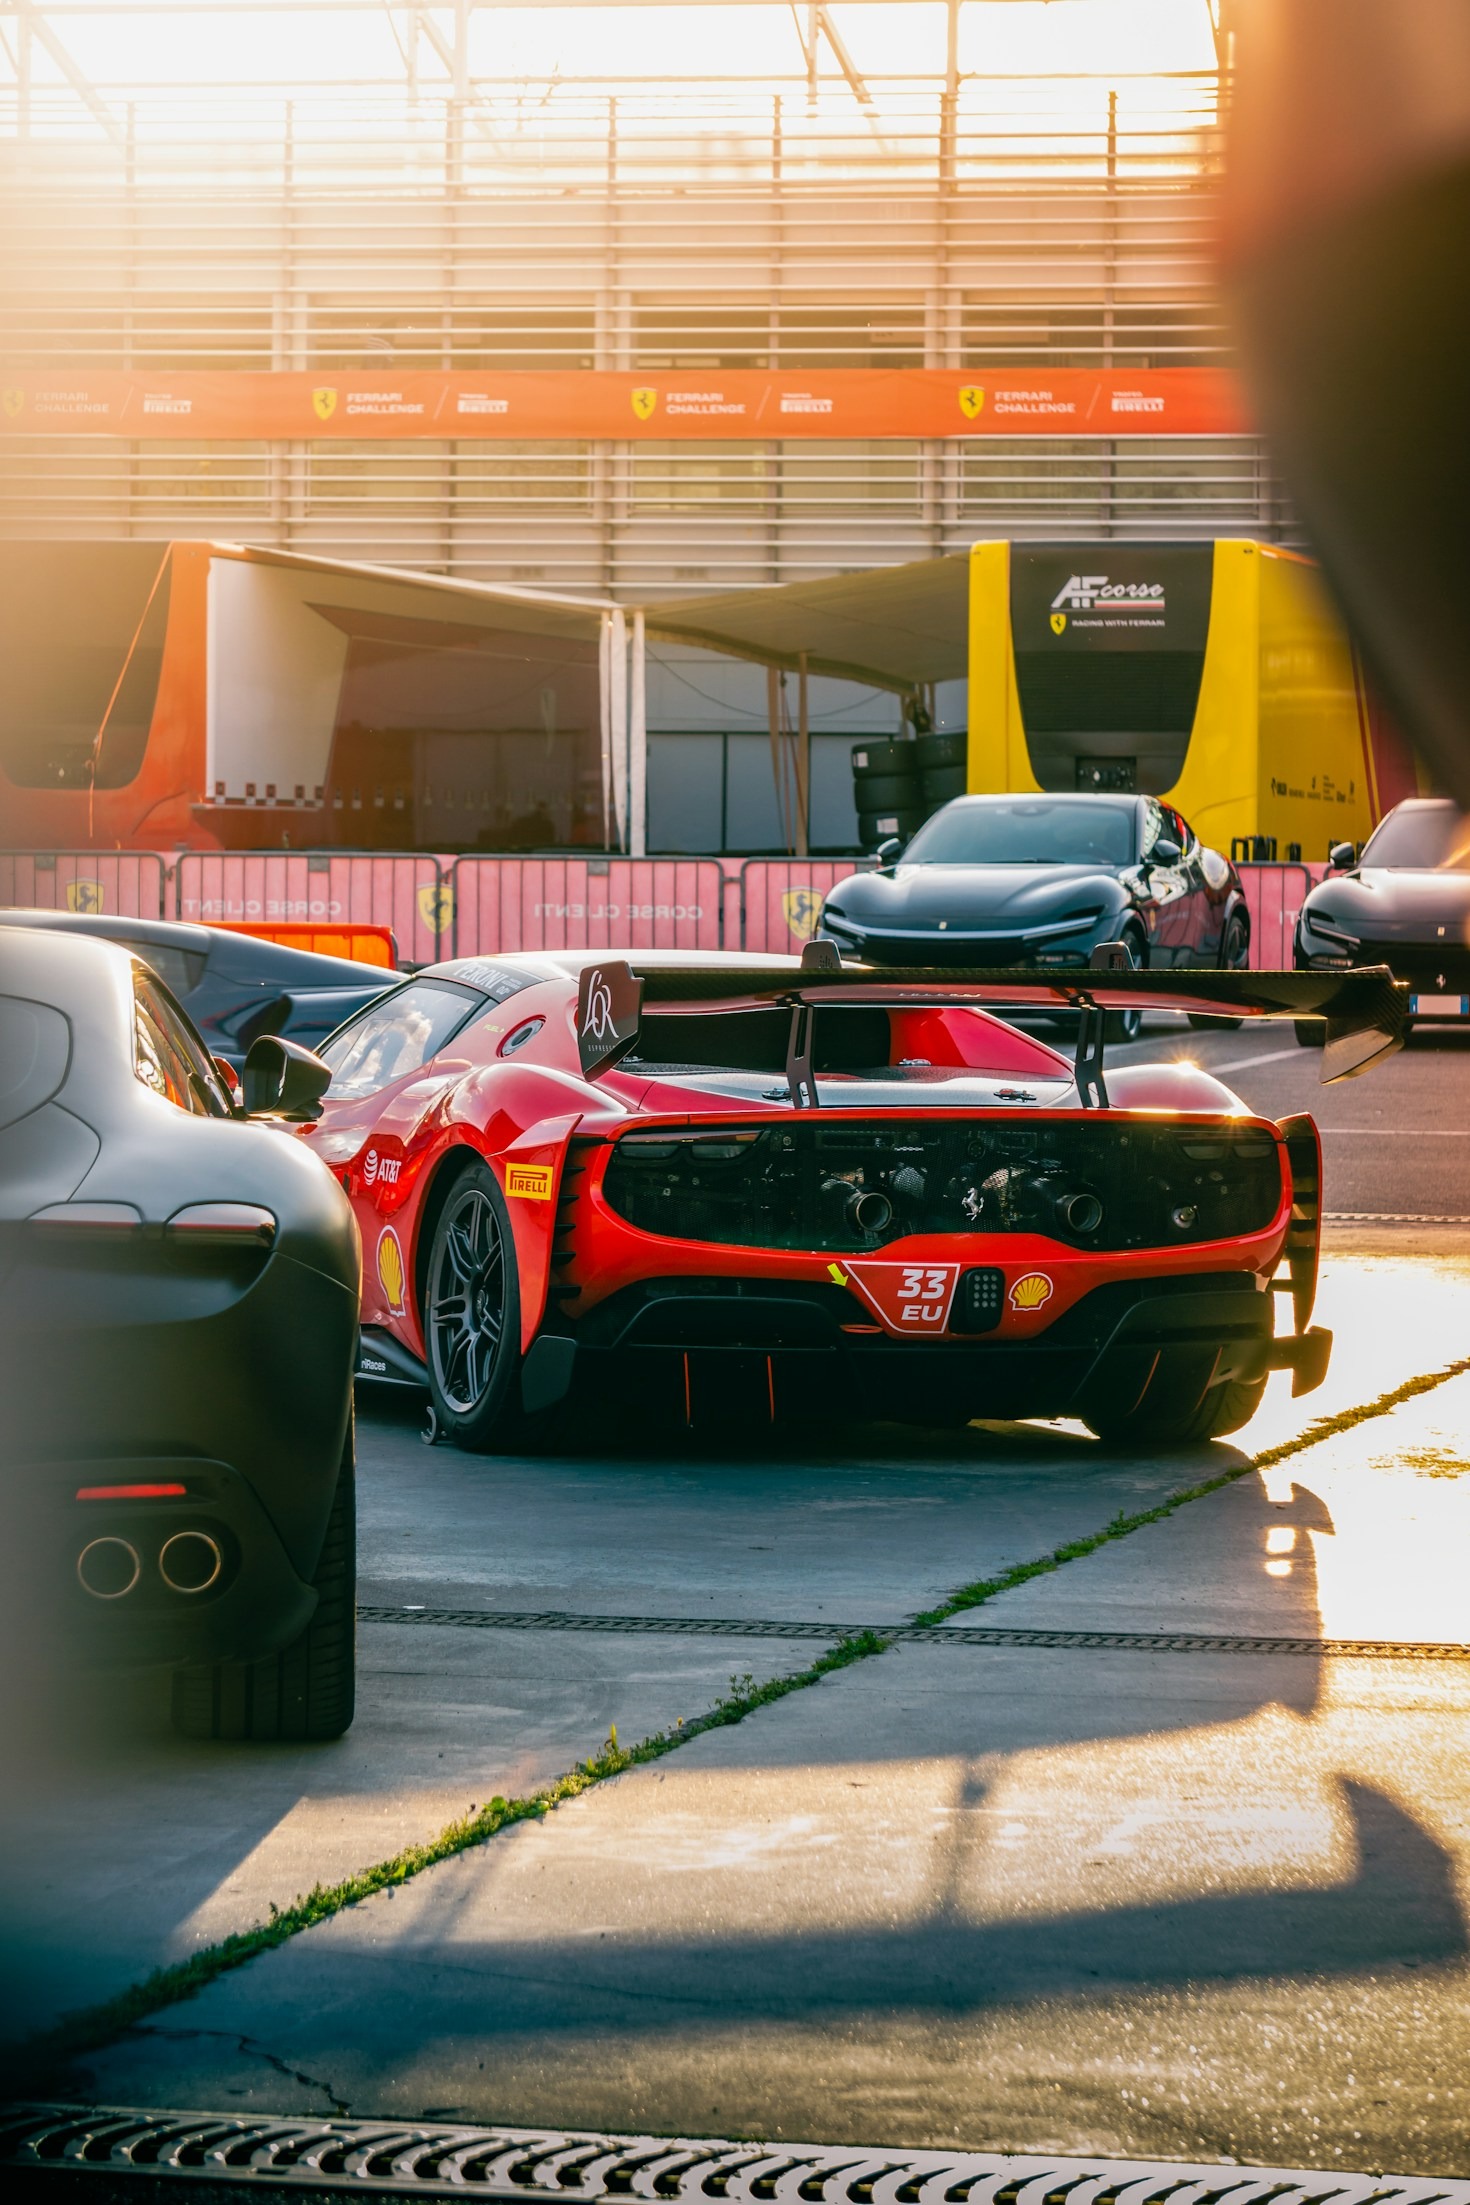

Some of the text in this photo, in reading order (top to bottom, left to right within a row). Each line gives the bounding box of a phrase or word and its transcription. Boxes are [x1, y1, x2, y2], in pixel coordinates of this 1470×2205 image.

[347, 393, 403, 402] FERRARI
[666, 393, 724, 402] FERRARI
[995, 391, 1052, 401] FERRARI
[346, 404, 425, 414] CHALLENGE
[457, 400, 509, 414] PIRELLI
[665, 404, 746, 414] CHALLENGE
[780, 399, 833, 413] PIRELLI
[994, 403, 1076, 413] CHALLENGE
[1111, 398, 1165, 412] PIRELLI
[453, 962, 509, 989] PERONI
[377, 1159, 401, 1183] AT&T
[510, 1169, 548, 1193] PIRELLI
[897, 1268, 948, 1299] 33
[901, 1304, 943, 1321] EU
[361, 1358, 386, 1371] riRaces
